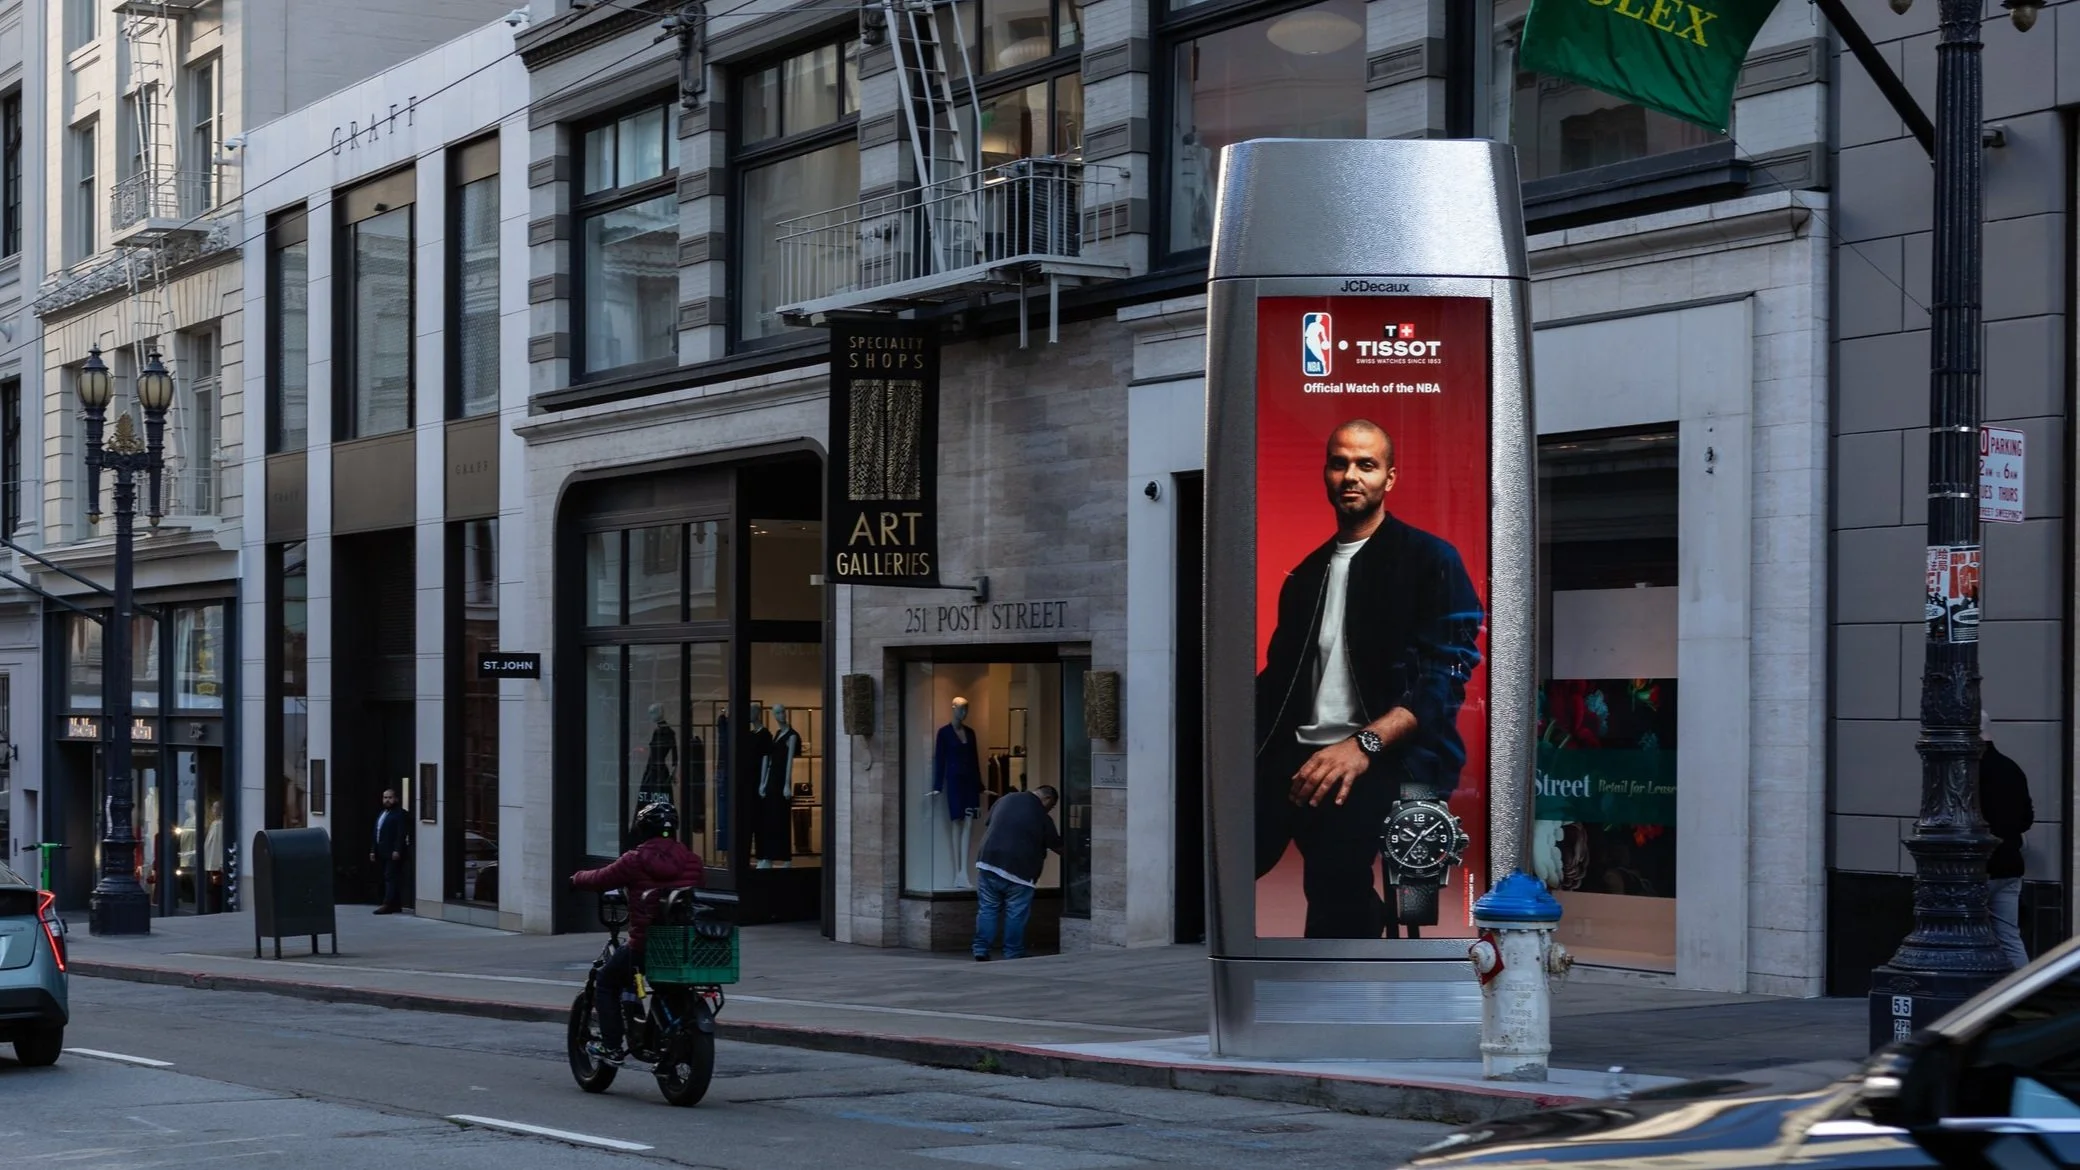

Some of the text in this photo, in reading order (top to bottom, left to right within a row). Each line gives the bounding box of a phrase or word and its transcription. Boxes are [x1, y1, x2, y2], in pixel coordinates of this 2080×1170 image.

[1588, 0, 1718, 47] LEX
[331, 96, 416, 155] GRAFF
[1341, 280, 1410, 292] JCDecaux
[849, 336, 923, 349] SPECIALTY
[1356, 341, 1441, 356] TISSOT
[849, 353, 923, 369] SHOPS
[1307, 361, 1321, 372] NBA
[1303, 382, 1441, 393] Official Watch of the NBA
[1991, 437, 2022, 457] PARKING
[848, 511, 923, 546] ART
[836, 552, 930, 576] GALLERIES
[905, 601, 1068, 633] 251 POST STREET
[483, 661, 533, 670] ST. JOHN
[1534, 768, 1591, 797] Street
[1598, 779, 1629, 793] Retail
[1628, 780, 1646, 797] for
[649, 792, 670, 803] JOHN
[1413, 813, 1425, 822] 12
[1391, 834, 1399, 843] 9
[1440, 834, 1447, 843] 3
[1894, 998, 1909, 1014] 55
